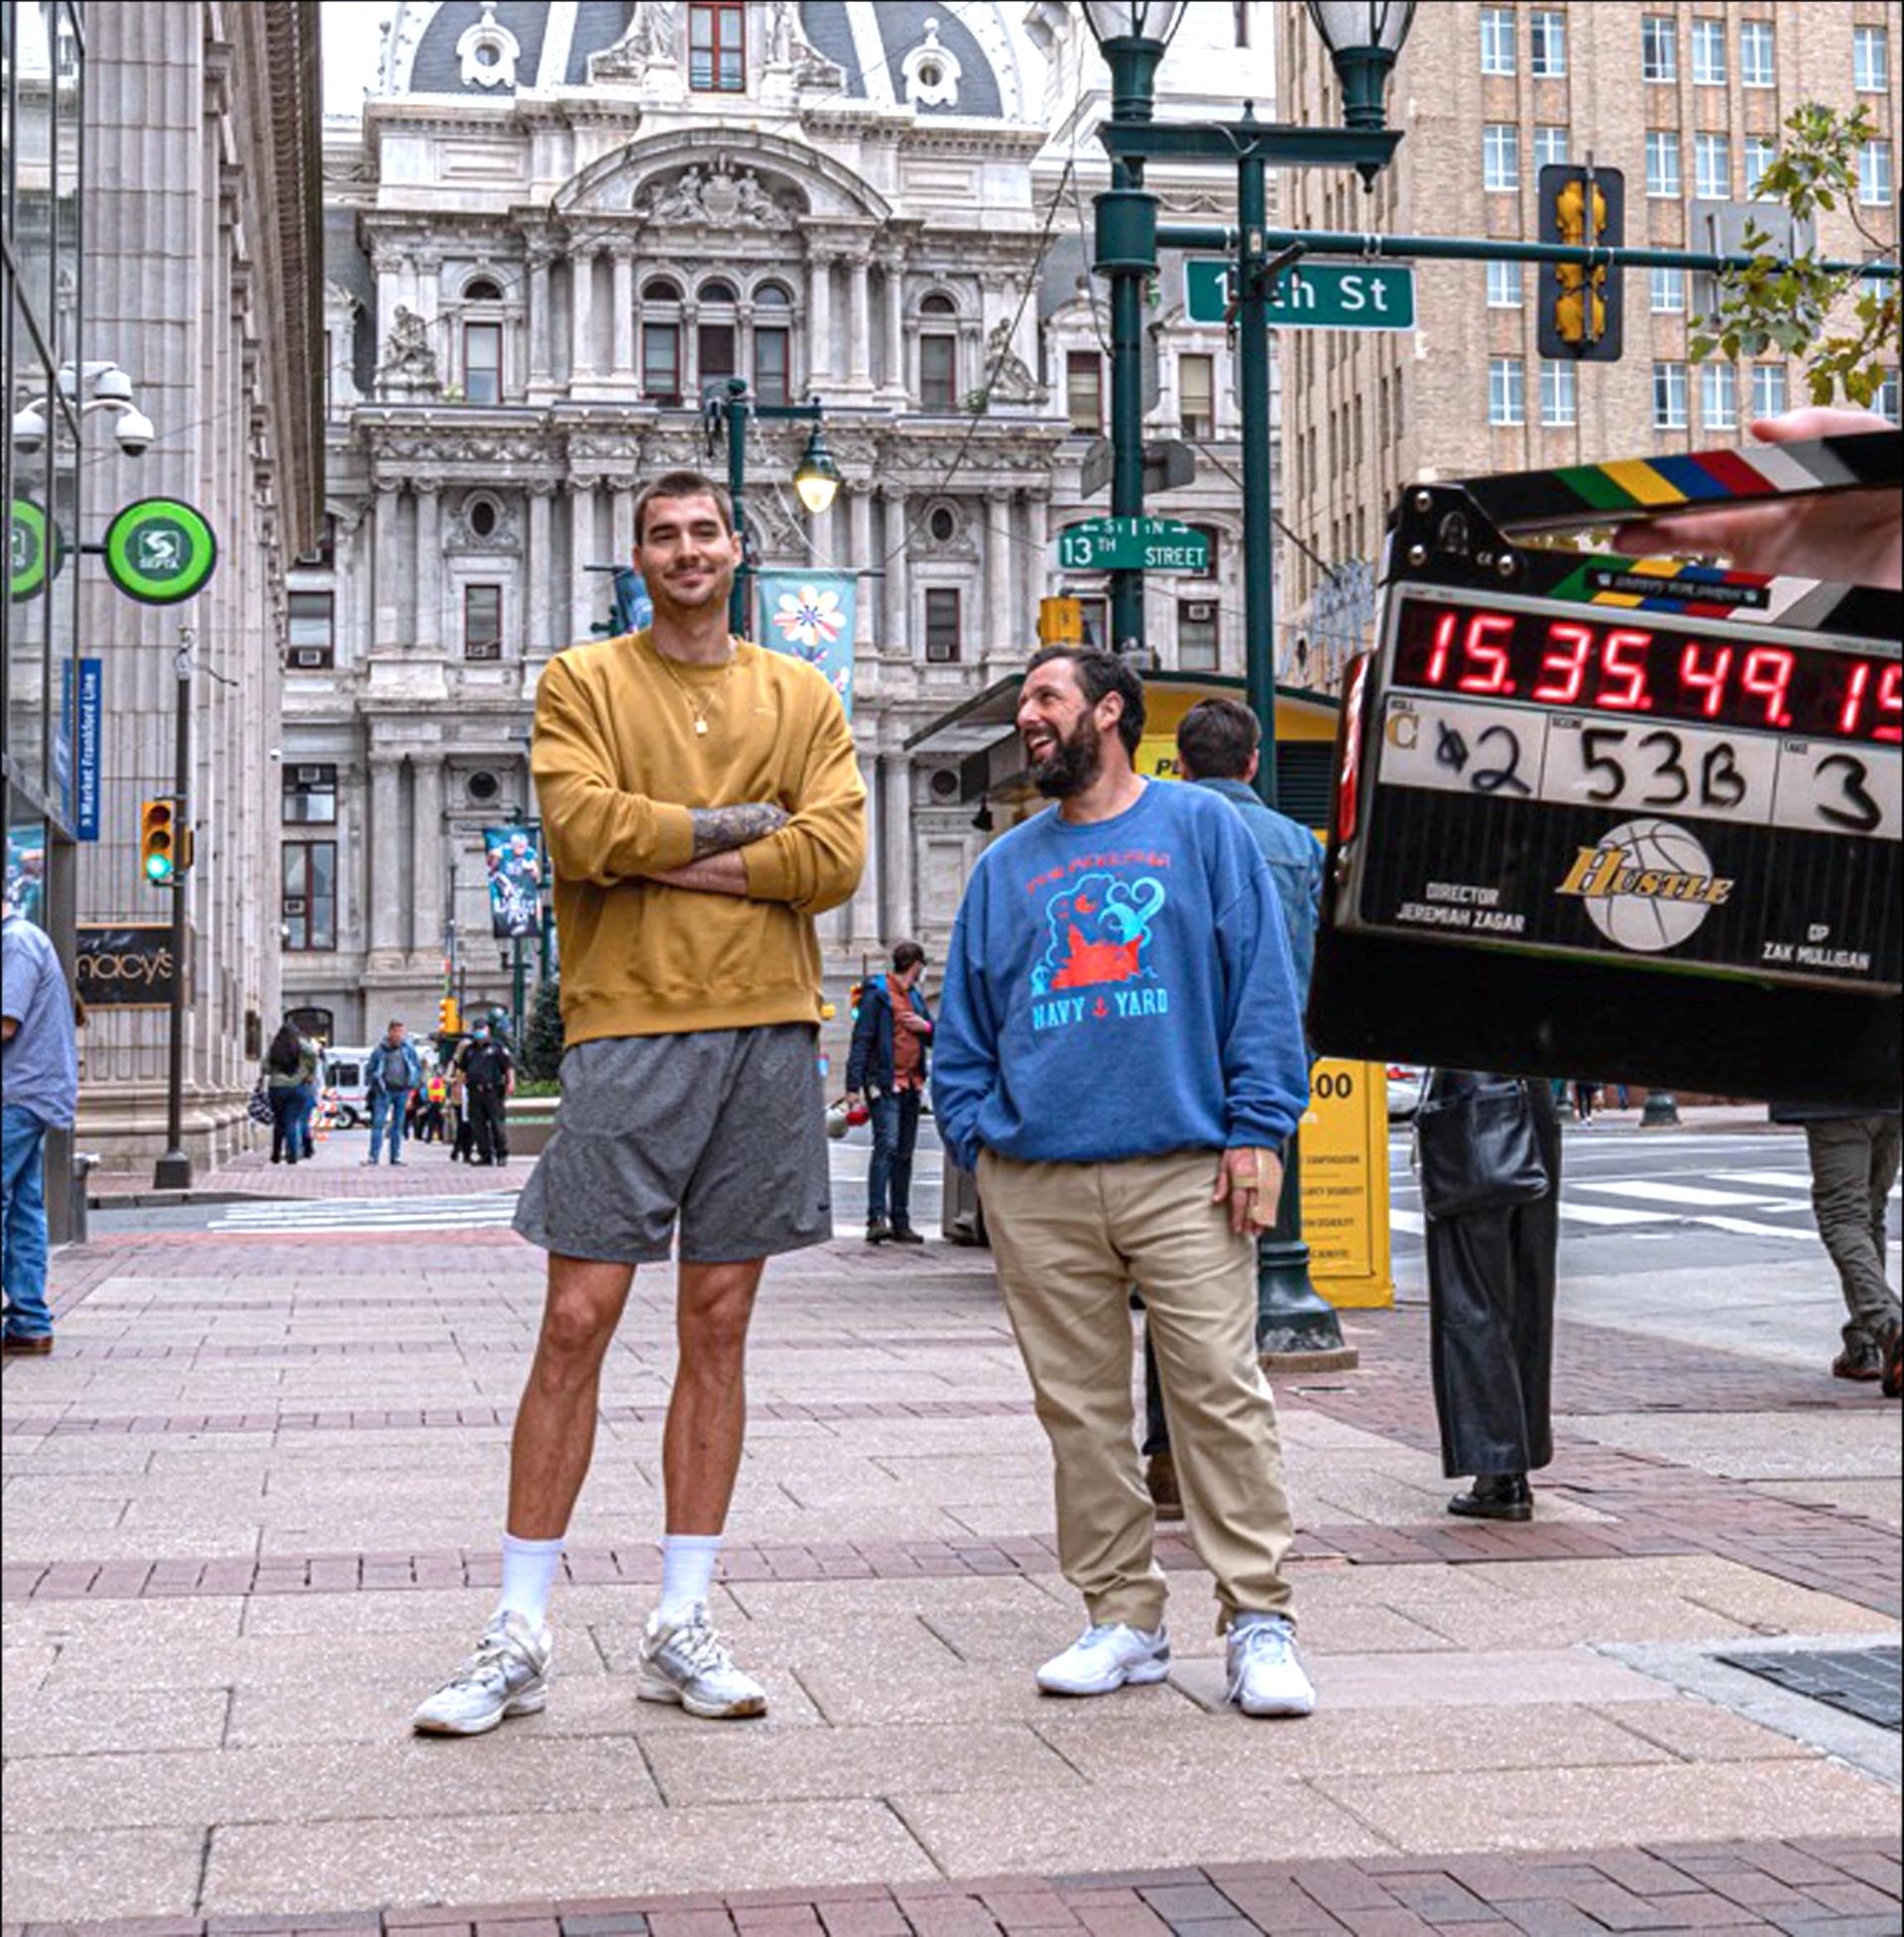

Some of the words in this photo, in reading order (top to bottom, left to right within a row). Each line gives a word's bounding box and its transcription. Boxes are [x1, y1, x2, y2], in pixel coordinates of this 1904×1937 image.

[1339, 275, 1388, 311] St
[1144, 546, 1206, 566] STREET
[1581, 728, 1746, 806] 53B
[1814, 753, 1882, 831] 3
[1425, 882, 1499, 906] DIRECTOR
[1396, 903, 1472, 926] JEREMIAH
[1472, 910, 1526, 933] ZAGAR
[1762, 942, 1794, 962] ZAK
[1796, 946, 1871, 971] MULLIGAN
[1032, 996, 1085, 1030] NAVY
[1114, 988, 1169, 1018] YARD
